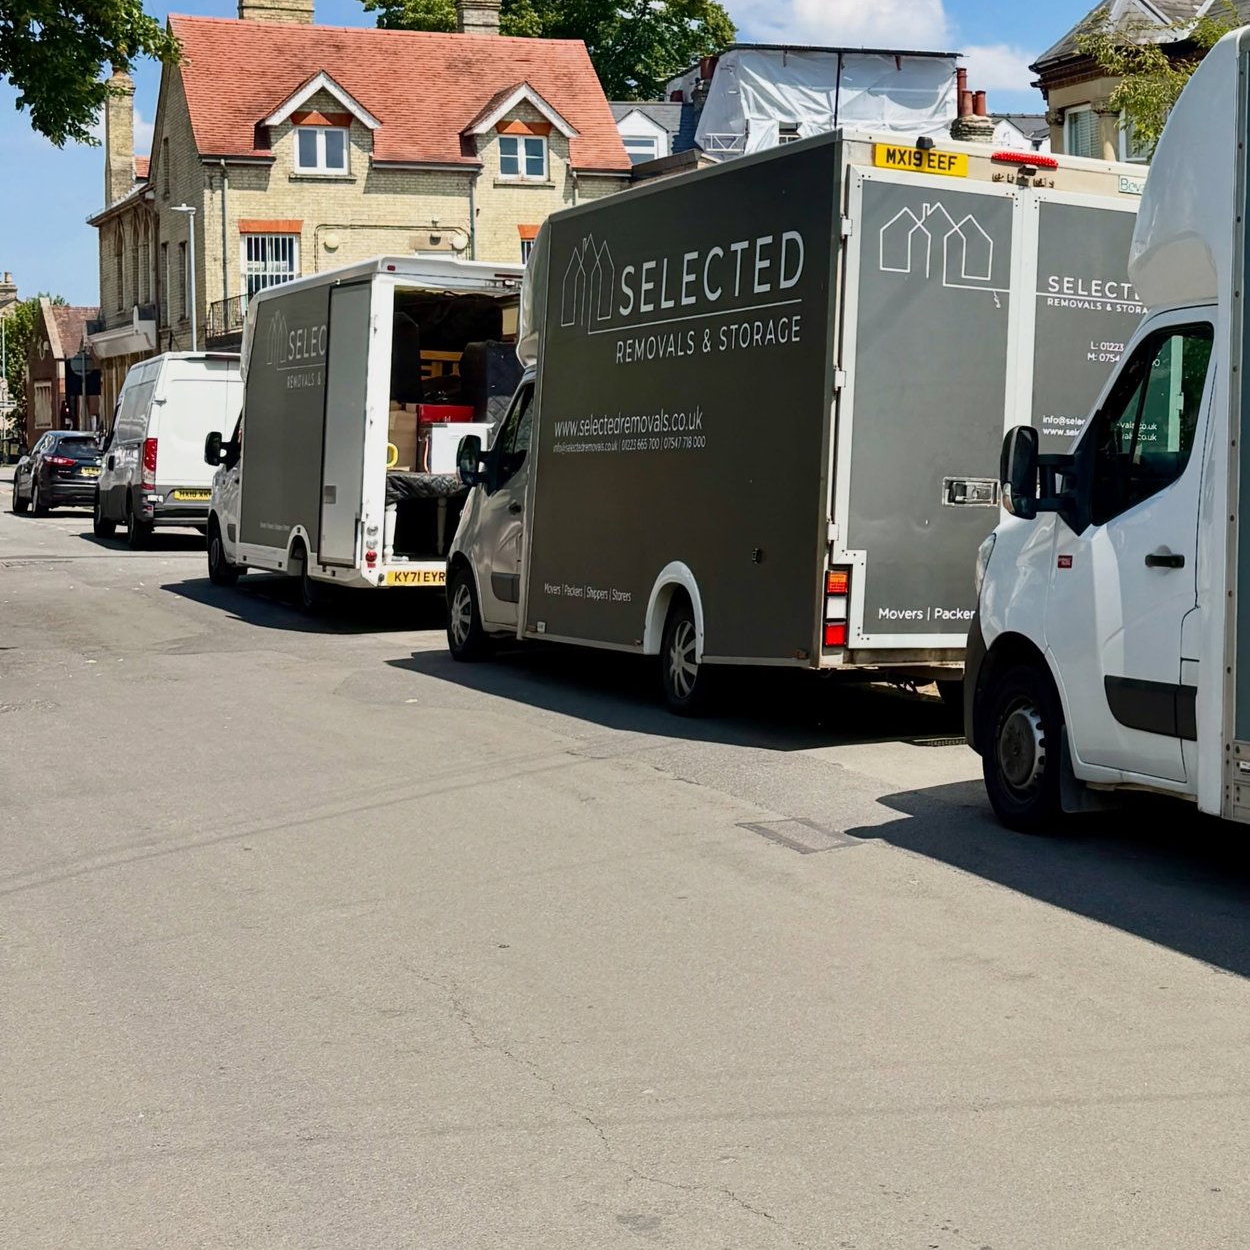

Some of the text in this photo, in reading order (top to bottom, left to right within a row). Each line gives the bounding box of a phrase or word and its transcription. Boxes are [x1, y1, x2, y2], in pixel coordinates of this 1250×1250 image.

[886, 148, 957, 170] MX19 EEF
[619, 230, 804, 316] SELECTED
[1047, 298, 1102, 311] REMOVALS
[1106, 303, 1112, 311] &
[616, 316, 801, 364] REMOVALS & STORAGE
[1100, 342, 1125, 352] 01223
[554, 406, 703, 438] www.selectedremovals.co.uk
[394, 571, 446, 582] KY71 EYR
[544, 583, 631, 602] Movers Packers Shippers Storers
[878, 607, 976, 620] Movers Packer
